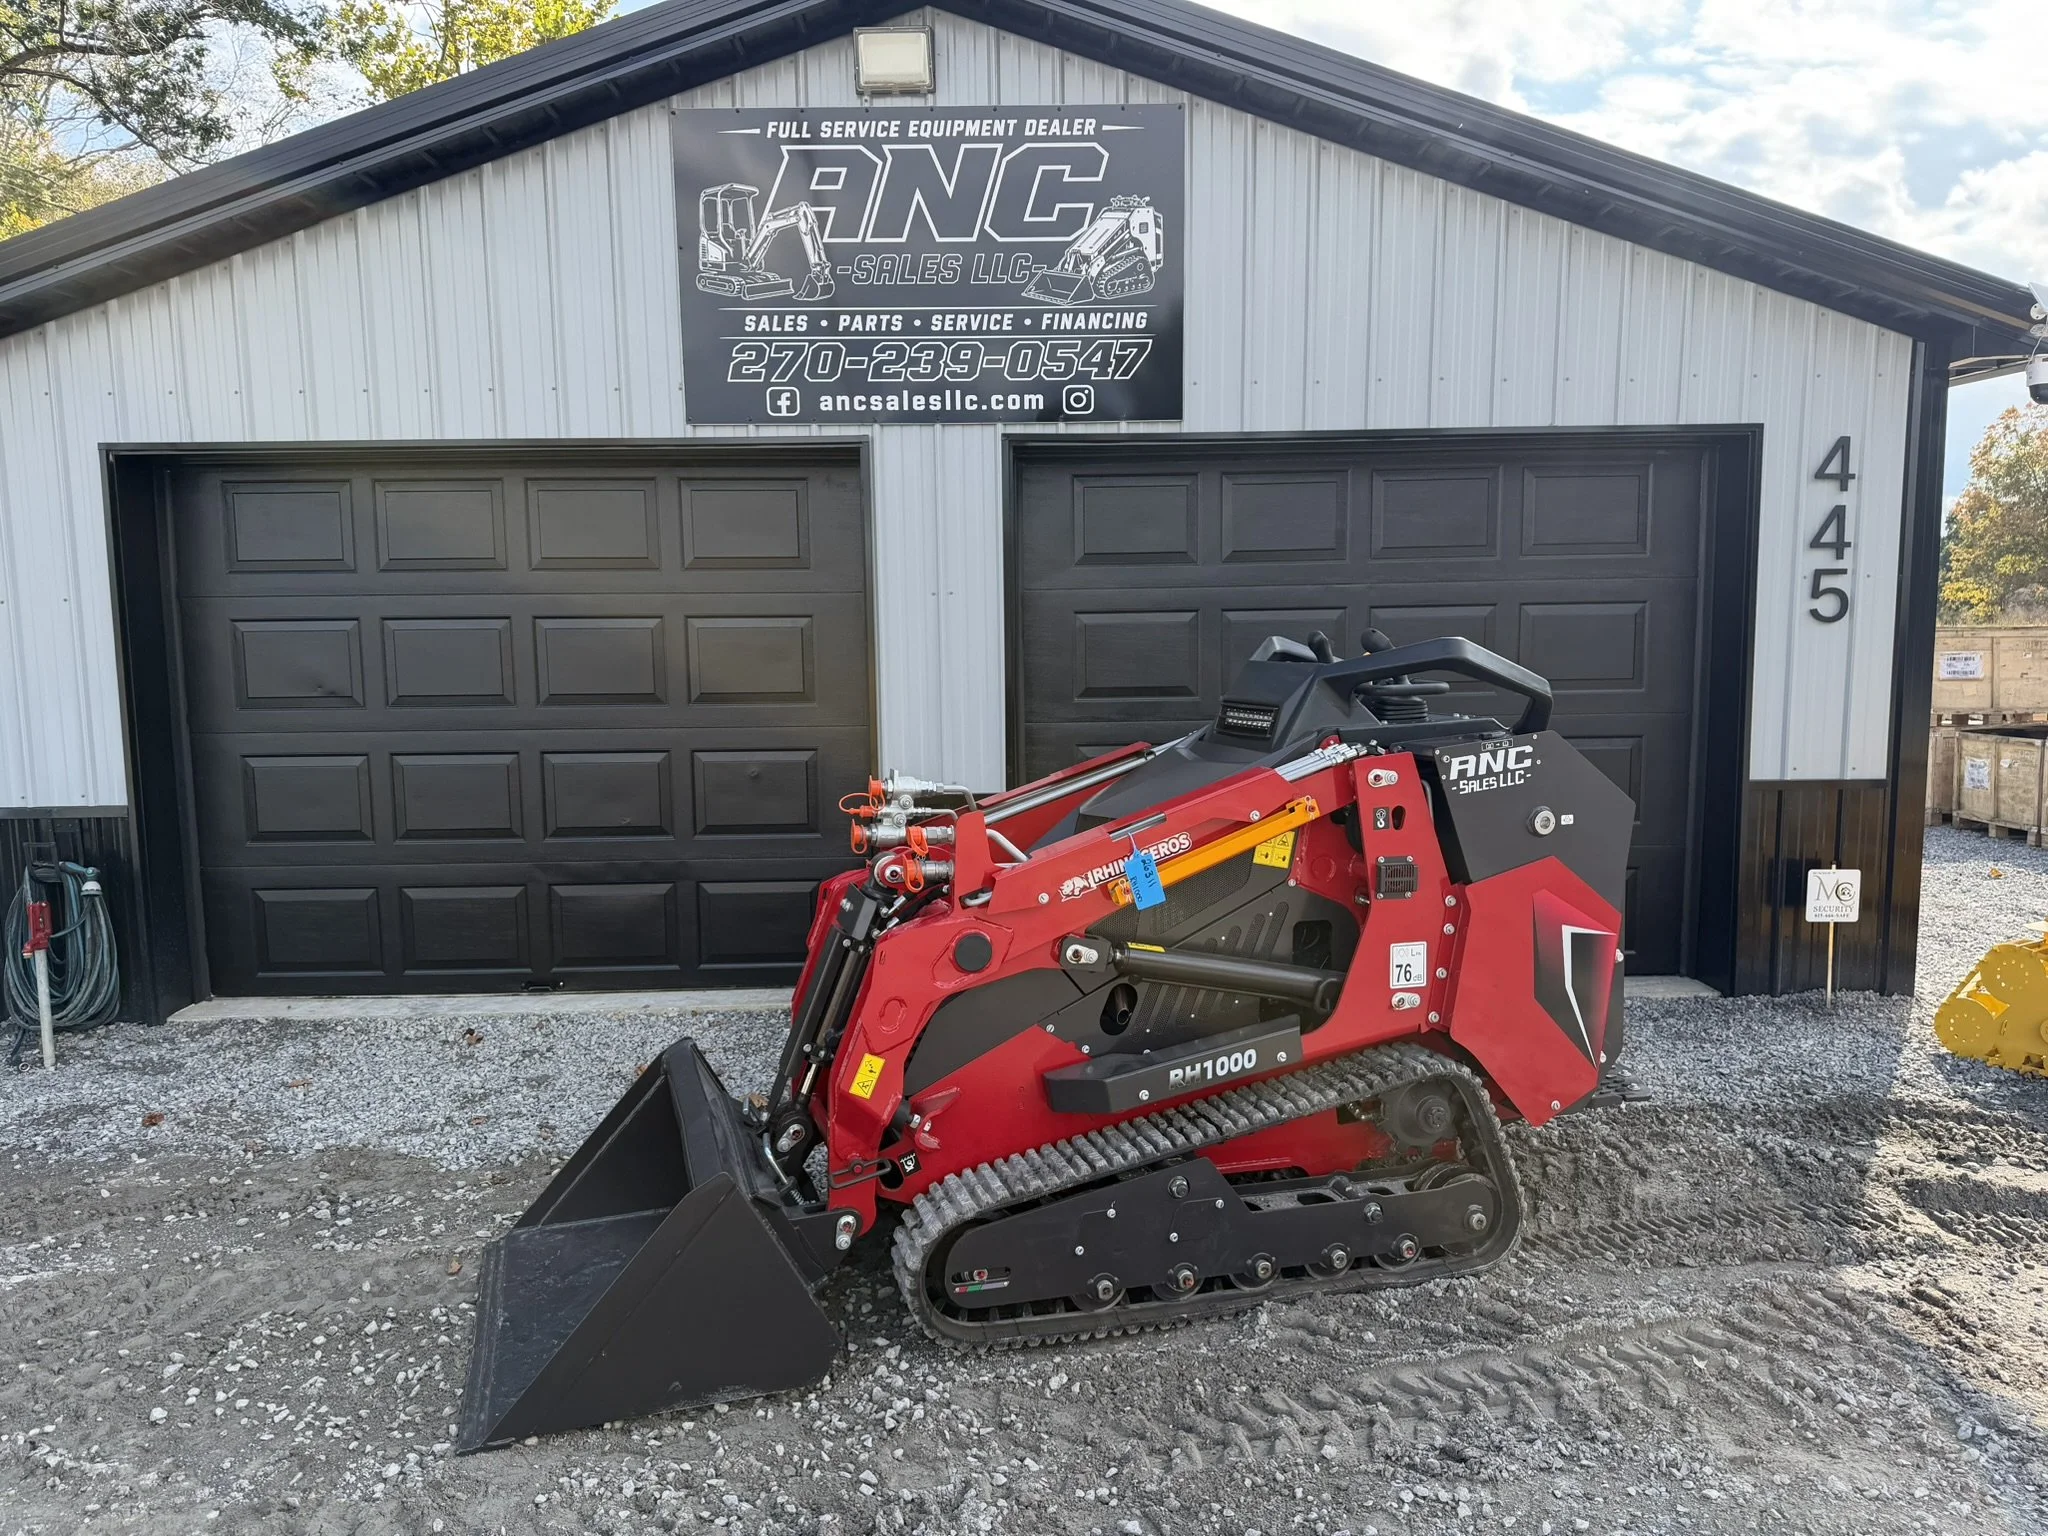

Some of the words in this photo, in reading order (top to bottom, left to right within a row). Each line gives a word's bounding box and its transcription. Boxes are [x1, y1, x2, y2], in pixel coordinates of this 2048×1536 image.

[766, 122, 811, 139] FULL
[820, 120, 901, 138] SERVICE
[908, 120, 1017, 137] EQUIPMENT
[1024, 118, 1096, 136] DEALER
[759, 142, 1109, 242] ANC
[745, 314, 808, 332] SALES
[838, 314, 903, 332] PARTS
[931, 313, 1013, 331] SERVICE
[1041, 312, 1148, 330] FINANCING
[728, 339, 1152, 383] 270-239-0547
[819, 389, 1044, 412] ancsalesllc.com
[1450, 745, 1533, 780] ANC
[1812, 904, 1854, 913] SECURITY
[1395, 963, 1412, 983] 76
[1169, 1048, 1257, 1091] RH1000
